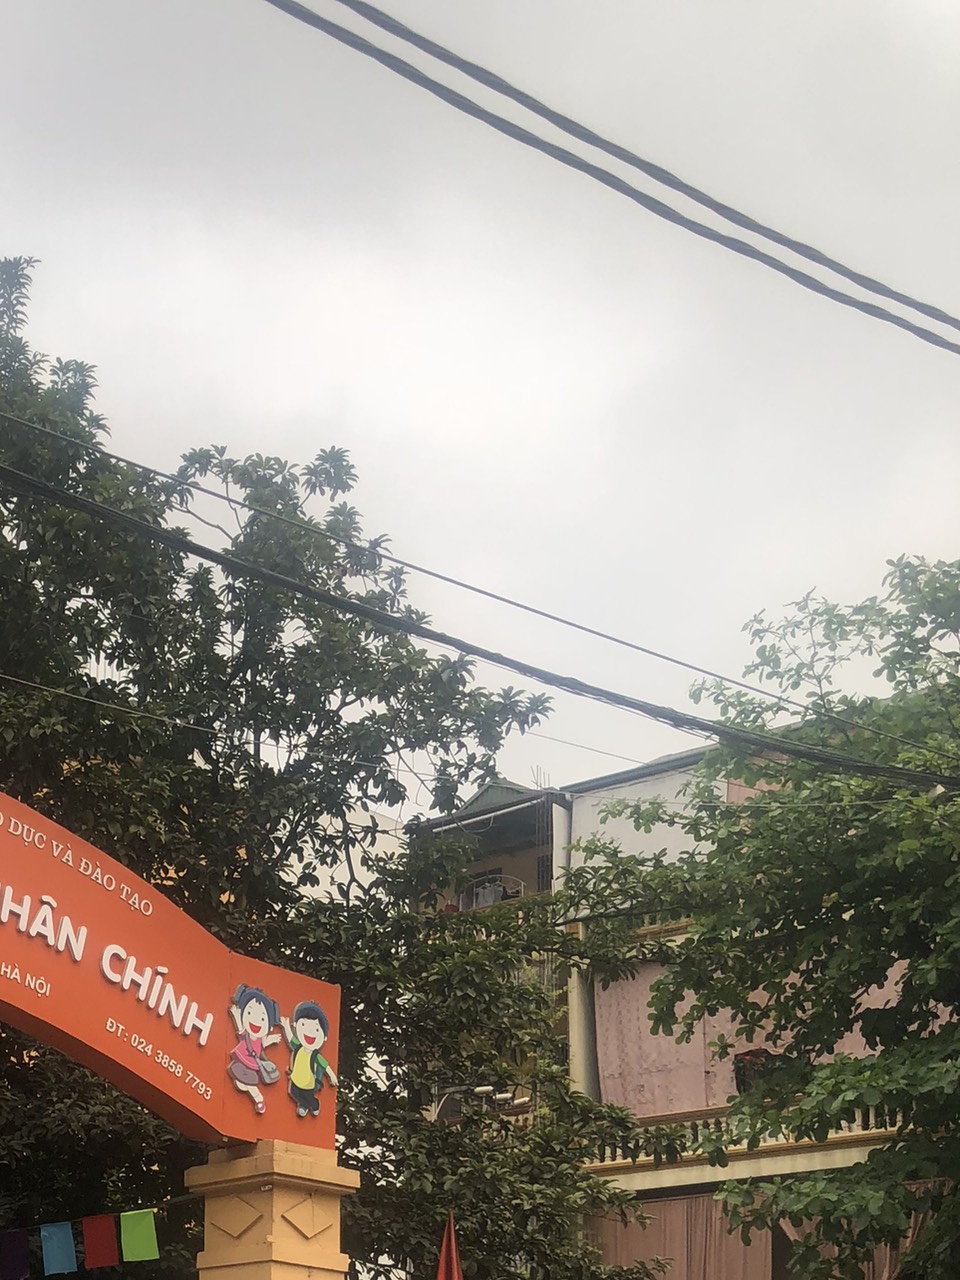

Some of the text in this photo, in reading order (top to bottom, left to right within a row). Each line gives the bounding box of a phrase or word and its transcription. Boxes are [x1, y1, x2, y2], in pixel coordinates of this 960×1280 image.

[8, 816, 47, 849] DỤC
[51, 838, 75, 868] VÀ
[78, 856, 117, 892] ĐÀO
[119, 882, 154, 917] TẠO
[0, 958, 22, 986] HÀ
[25, 971, 51, 998] NỘI
[99, 943, 215, 1047] CHÍNH
[130, 1033, 153, 1057] 024
[155, 1050, 184, 1078] 3858
[185, 1070, 214, 1101] 7793
